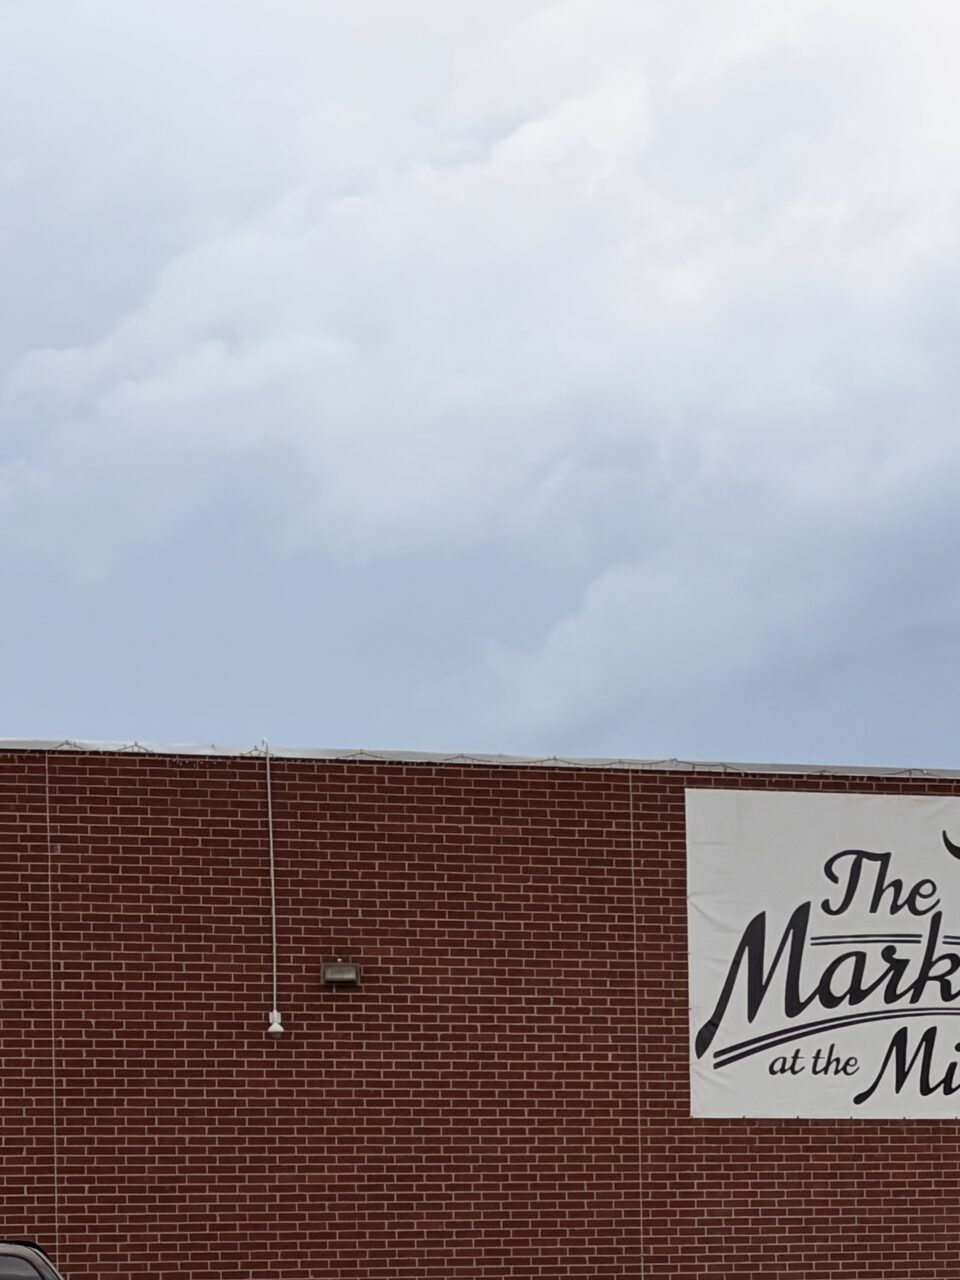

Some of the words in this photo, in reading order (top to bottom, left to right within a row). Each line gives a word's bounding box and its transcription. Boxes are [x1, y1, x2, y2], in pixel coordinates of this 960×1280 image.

[821, 849, 941, 916] The
[768, 1048, 805, 1076] at
[811, 1043, 860, 1076] the
